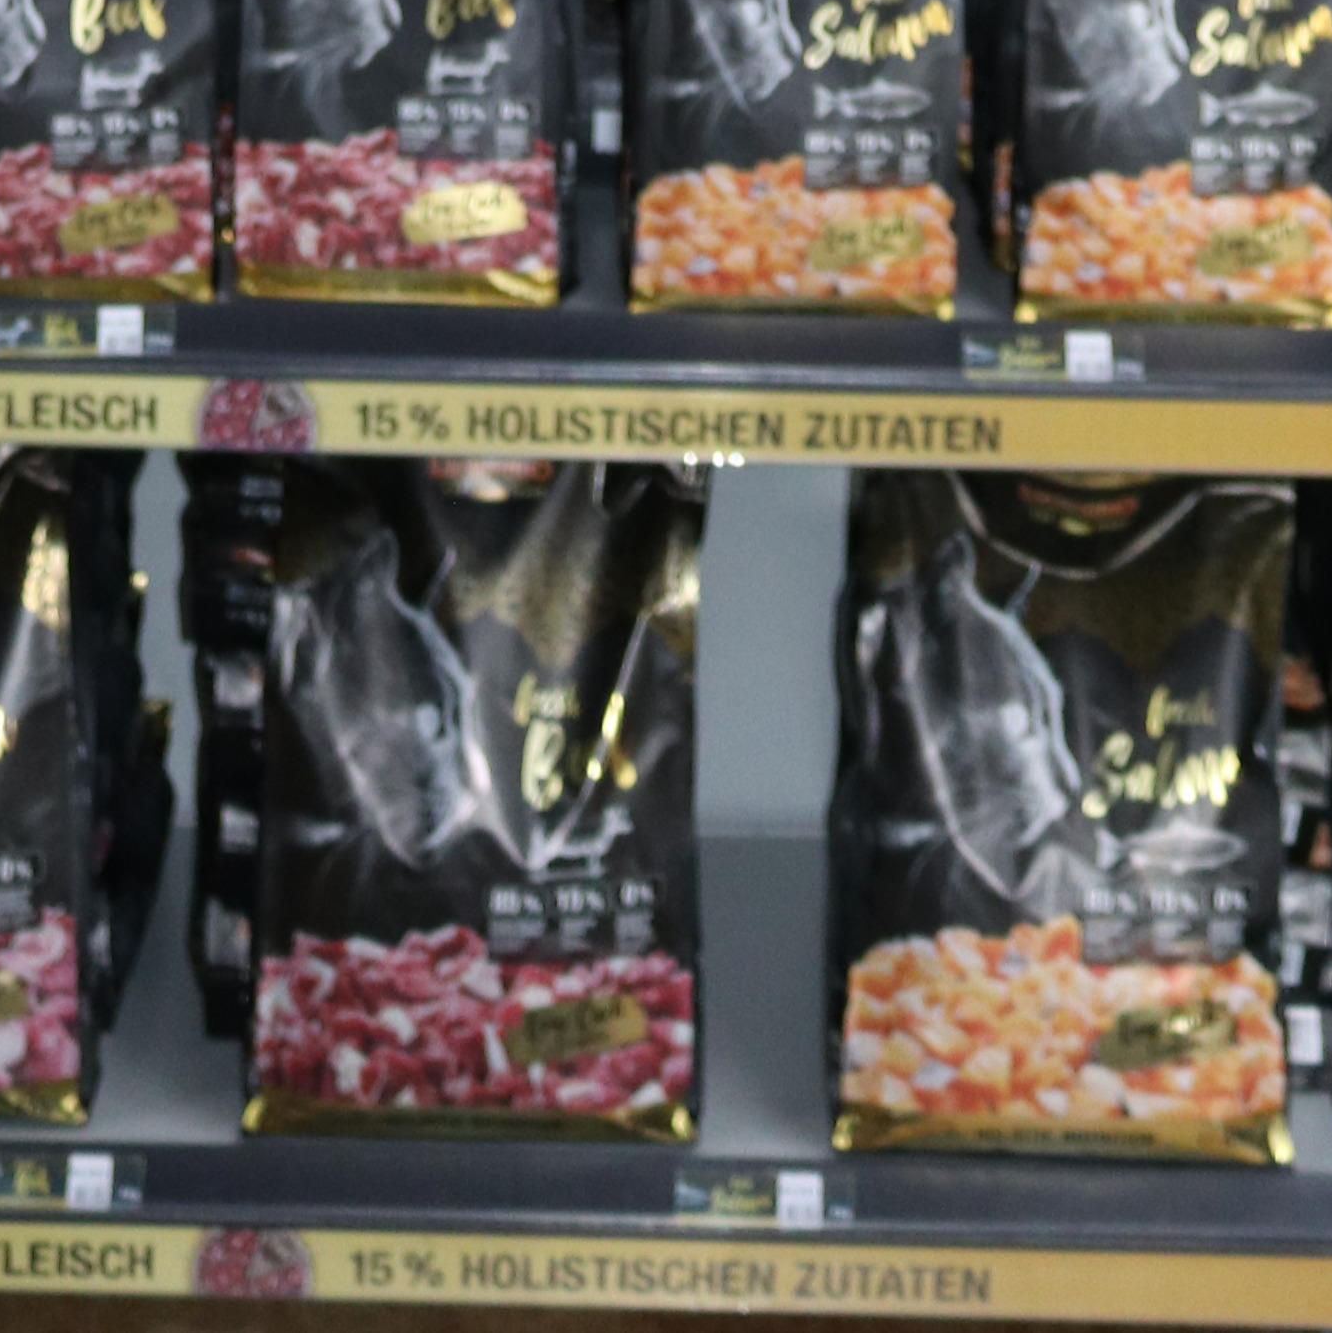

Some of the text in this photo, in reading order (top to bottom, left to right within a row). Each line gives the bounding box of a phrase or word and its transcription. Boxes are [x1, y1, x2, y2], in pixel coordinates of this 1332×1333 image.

[356, 402, 400, 441] 15
[467, 404, 786, 449] HOLISTISCHEN
[803, 412, 1003, 455] ZUTATEN
[350, 1250, 394, 1289] 15
[461, 1254, 778, 1299] HOLISTISCHEN
[794, 1262, 992, 1306] ZUTATEN
